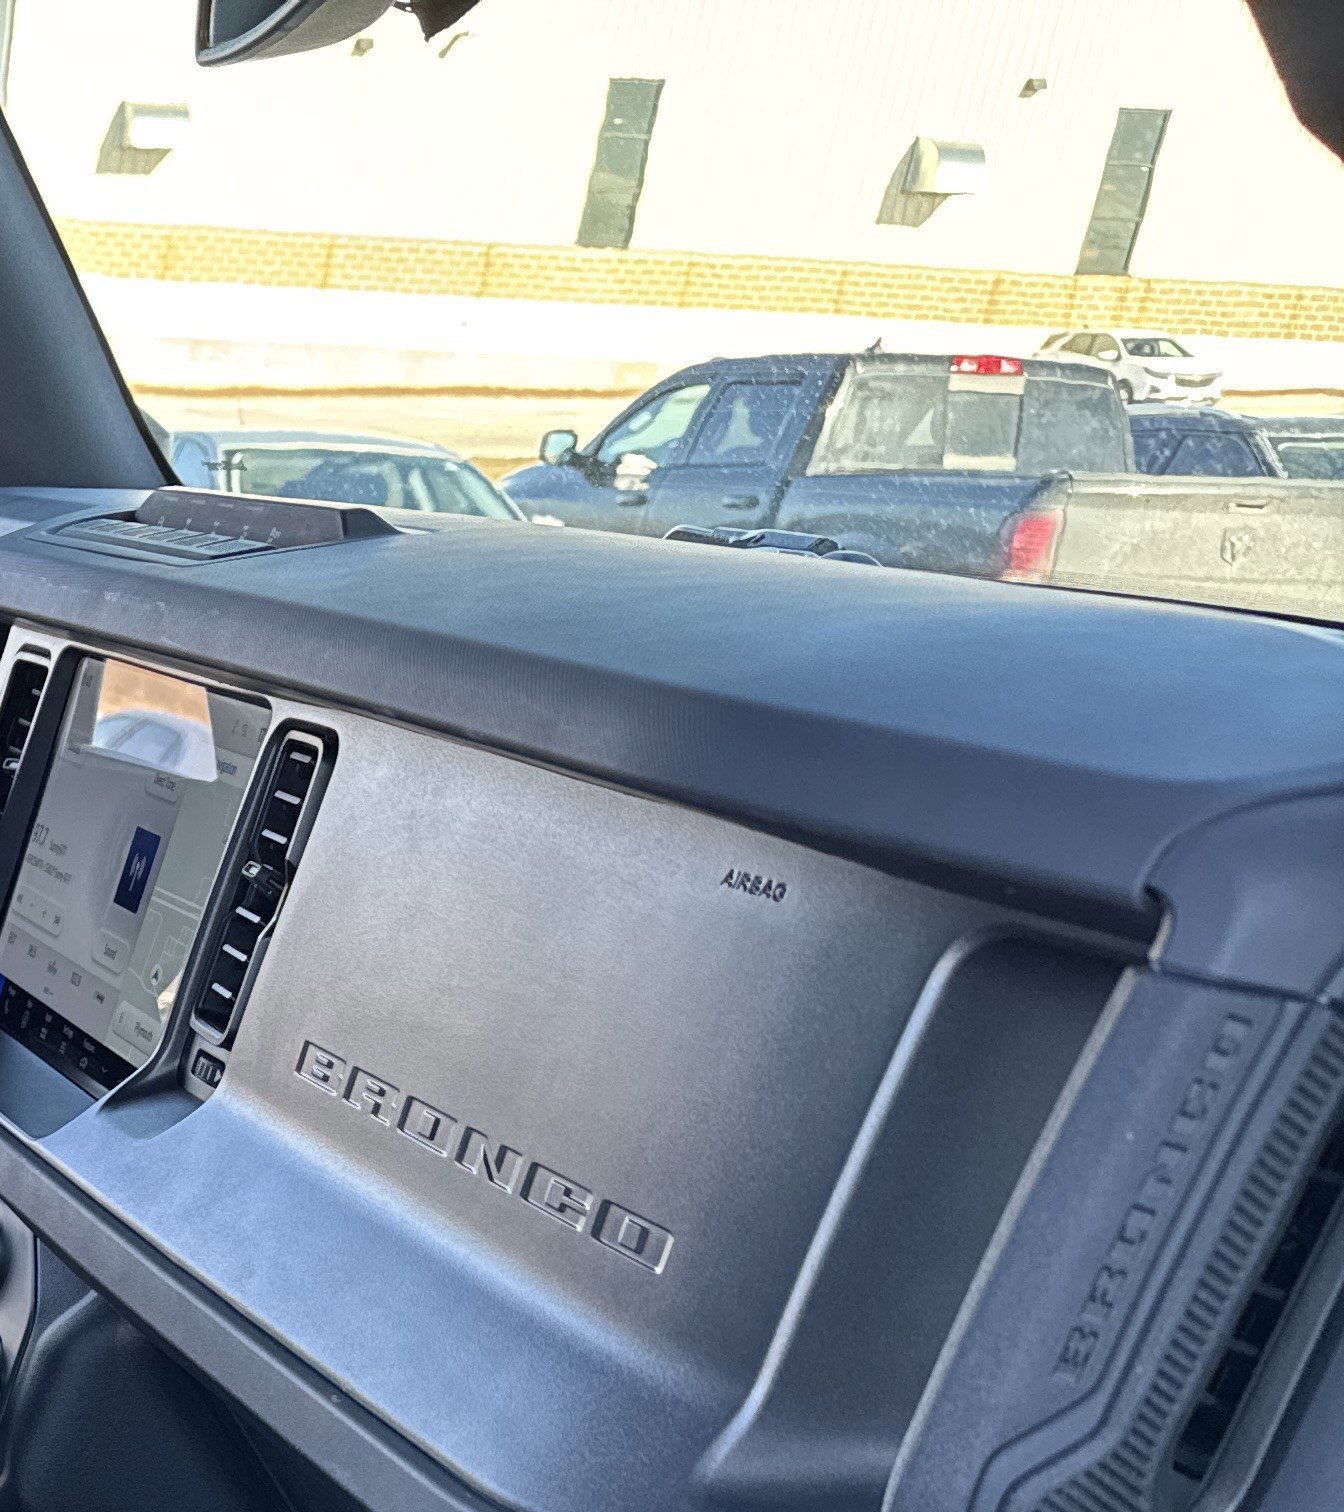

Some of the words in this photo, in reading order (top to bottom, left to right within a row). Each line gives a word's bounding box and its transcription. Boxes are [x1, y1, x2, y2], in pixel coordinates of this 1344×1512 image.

[720, 868, 787, 902] AIRBAG
[294, 1039, 675, 1275] BRONCO
[1050, 1011, 1253, 1385] BRONCO
